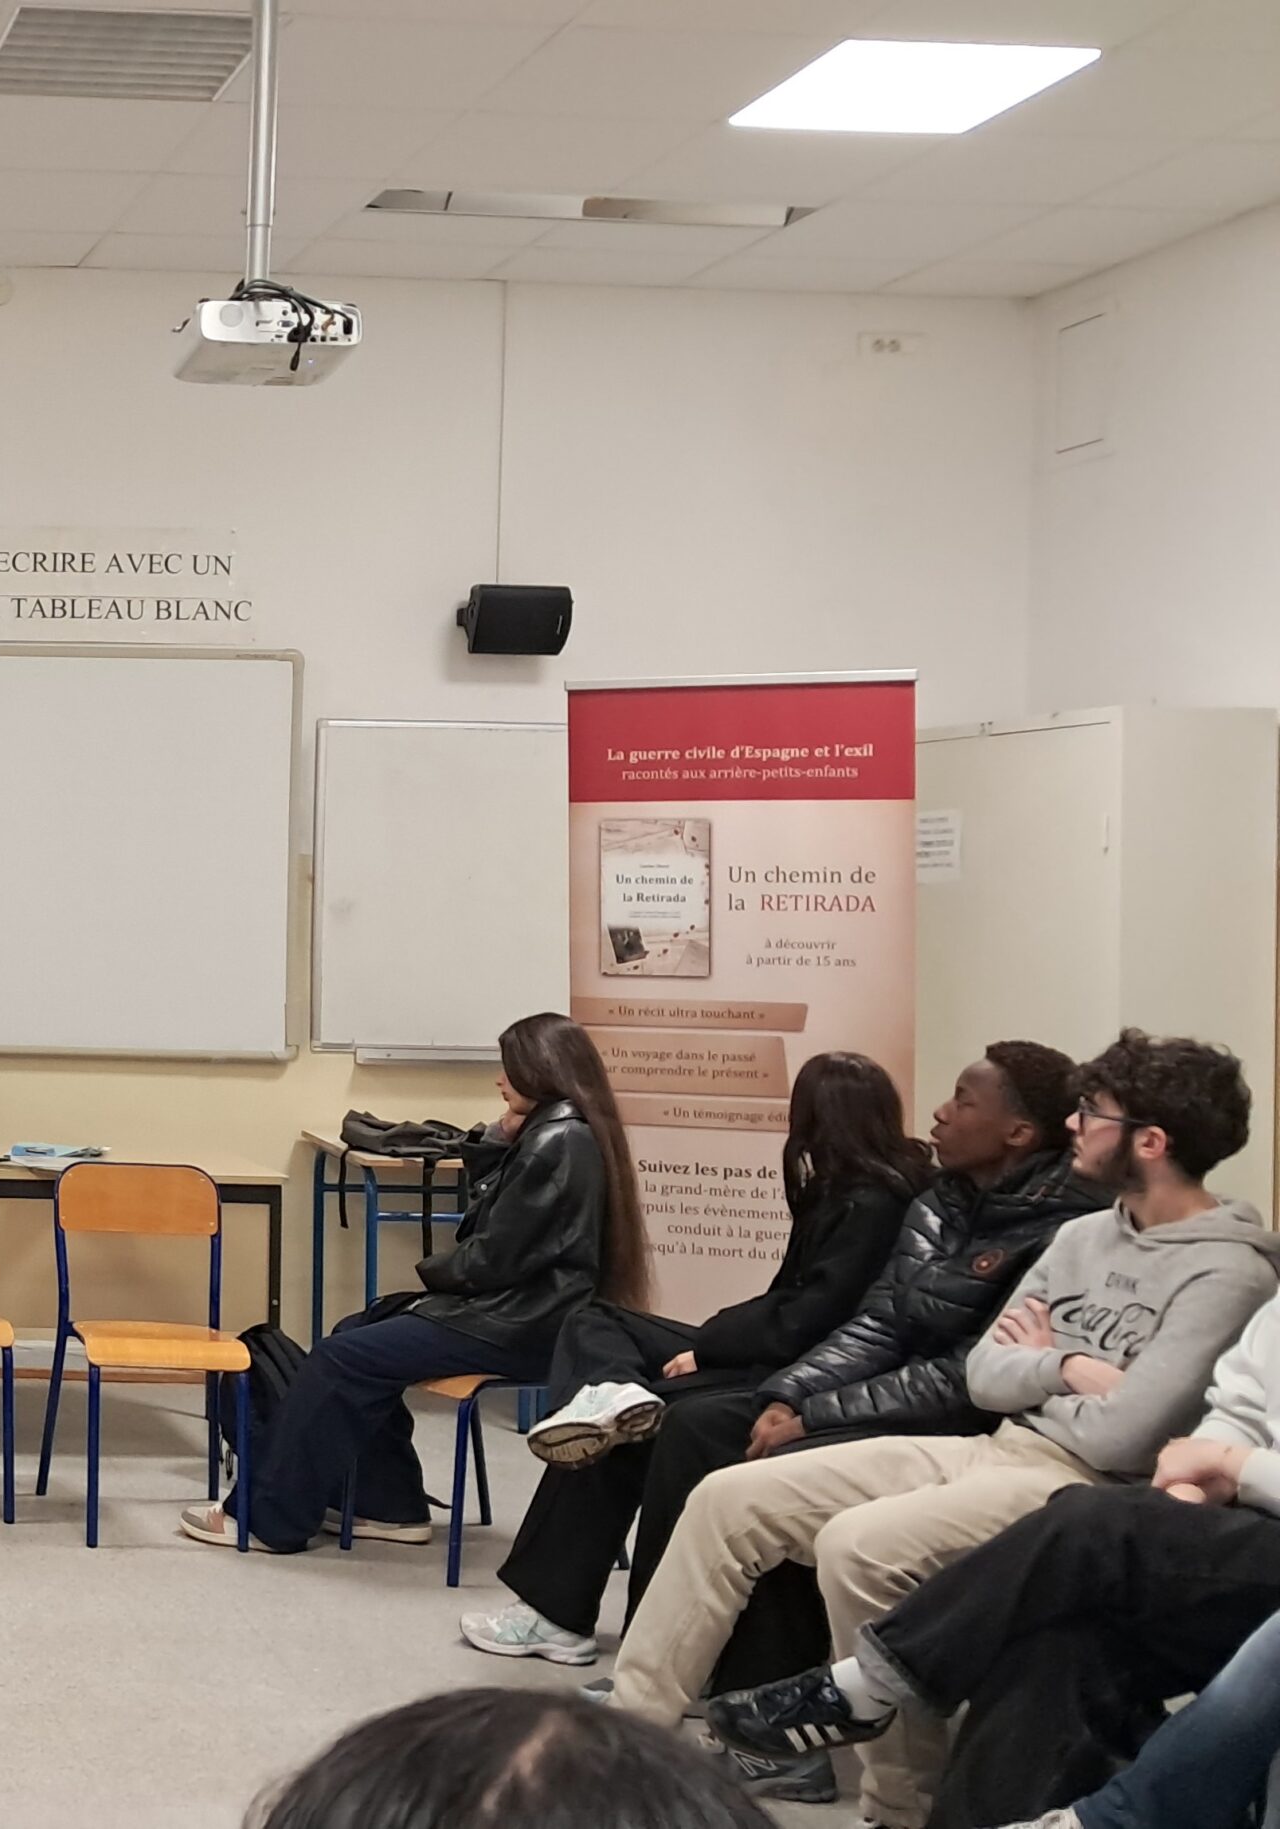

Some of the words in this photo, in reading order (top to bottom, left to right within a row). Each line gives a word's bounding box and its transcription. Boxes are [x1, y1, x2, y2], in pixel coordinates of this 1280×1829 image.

[105, 553, 183, 574] AVEC
[192, 555, 233, 576] UN
[11, 597, 145, 620] TABLEAU
[155, 600, 253, 622] BLANC
[607, 748, 625, 761] La
[629, 749, 681, 764] guerre
[685, 745, 726, 759] civile
[730, 745, 810, 762] d'Espagne
[814, 746, 831, 758] et
[835, 743, 874, 757] l'exil
[622, 767, 679, 780] racontés
[682, 769, 707, 779] aux
[709, 764, 859, 780] arrière-petits-enfants
[616, 873, 632, 885] Un
[635, 874, 677, 885] chemin
[680, 874, 694, 885] de
[727, 866, 756, 883] Un
[764, 864, 842, 884] chemin
[849, 864, 877, 884] de
[623, 892, 634, 903] la
[636, 892, 687, 903] Retirada
[728, 893, 746, 912] la
[760, 893, 877, 912] RETIRADA
[765, 937, 773, 950] à
[776, 937, 837, 951] découvrir
[746, 955, 754, 967] à
[757, 954, 793, 971] partir
[797, 954, 812, 967] de
[816, 954, 832, 967] 15
[835, 957, 857, 967] ans
[618, 1006, 635, 1017] Un
[638, 1006, 665, 1018] récit
[668, 1008, 697, 1019] ultra
[700, 1008, 755, 1020] touchant
[611, 1047, 628, 1058] Un
[631, 1050, 673, 1062] voyage
[675, 1050, 705, 1061] dans
[707, 1051, 718, 1062] le
[721, 1052, 756, 1063] passé
[621, 1066, 694, 1077] comprendre
[697, 1067, 708, 1077] le
[711, 1068, 759, 1080] présent
[672, 1107, 690, 1119] Un
[693, 1108, 765, 1123] témoignage
[638, 1159, 691, 1176] Suivez
[695, 1162, 719, 1177] les
[723, 1167, 753, 1181] pas
[757, 1166, 778, 1180] de
[645, 1181, 657, 1193] la
[661, 1183, 747, 1199] grand-mère
[751, 1186, 768, 1199] de
[639, 1202, 675, 1215] puis
[680, 1201, 700, 1214] les
[704, 1204, 793, 1221] évènements
[667, 1223, 722, 1237] conduit
[726, 1224, 734, 1238] à
[738, 1226, 752, 1239] la
[755, 1230, 790, 1243] guer
[691, 1242, 705, 1255] la
[708, 1246, 744, 1259] mort
[748, 1247, 767, 1260] du
